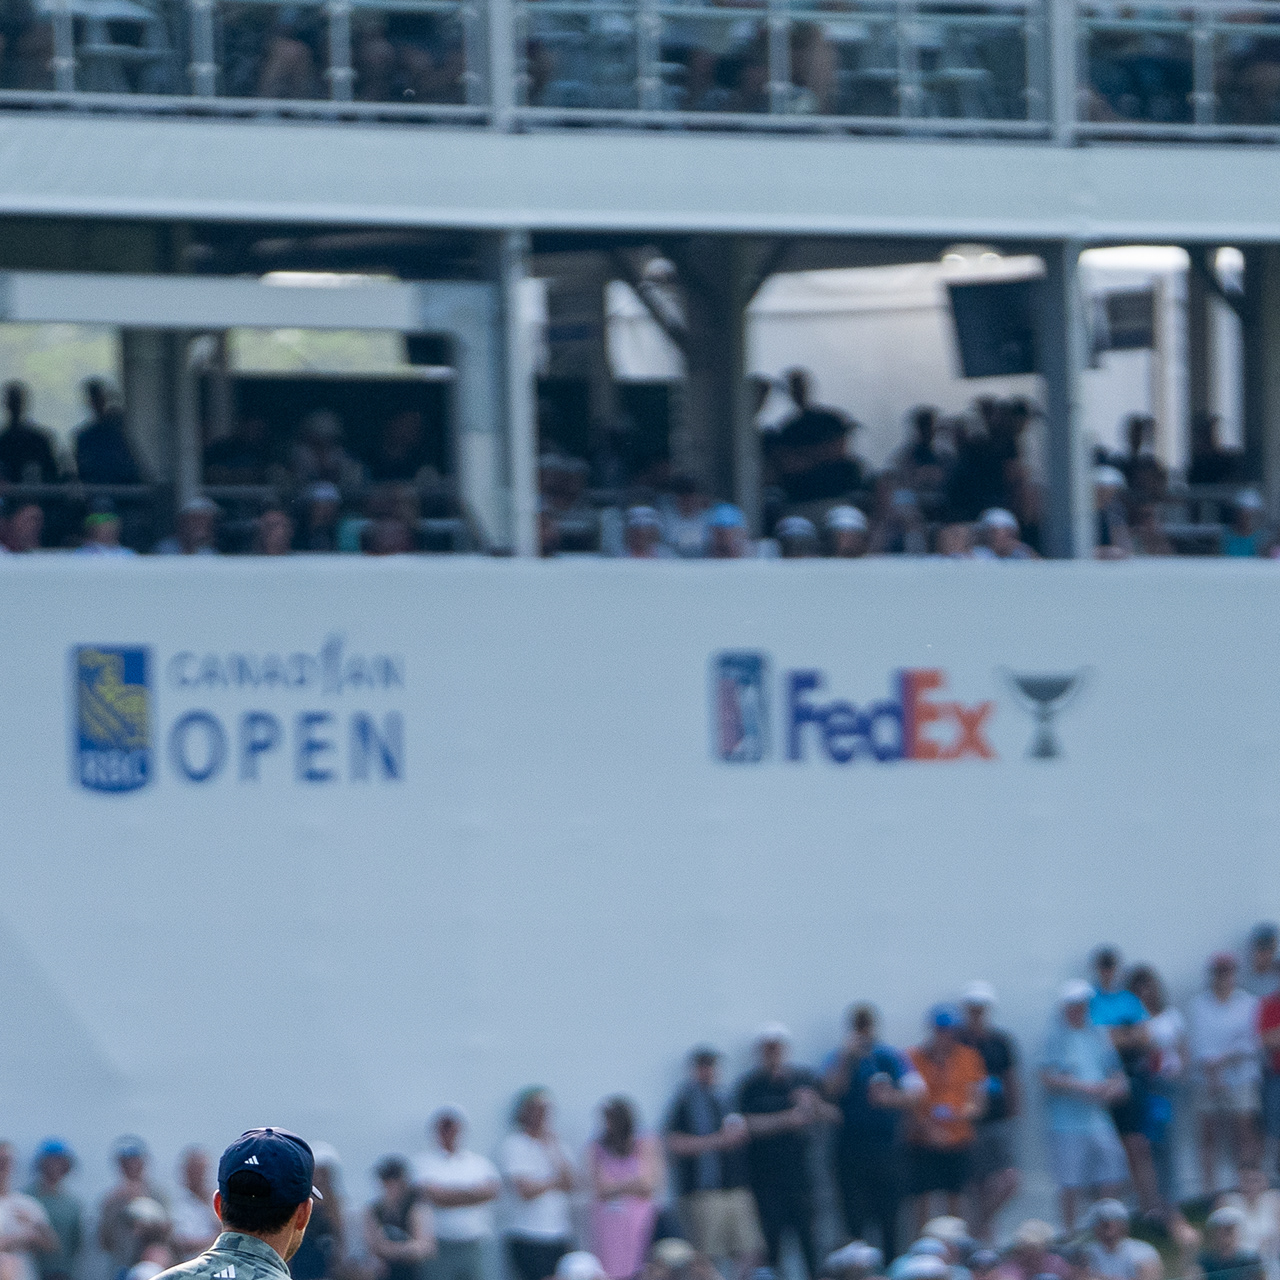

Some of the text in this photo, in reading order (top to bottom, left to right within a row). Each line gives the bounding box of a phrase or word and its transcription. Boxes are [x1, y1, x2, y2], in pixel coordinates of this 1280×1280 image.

[170, 634, 406, 692] CANADIAN
[170, 707, 405, 784] OPEN
[785, 667, 997, 765] FedEx
